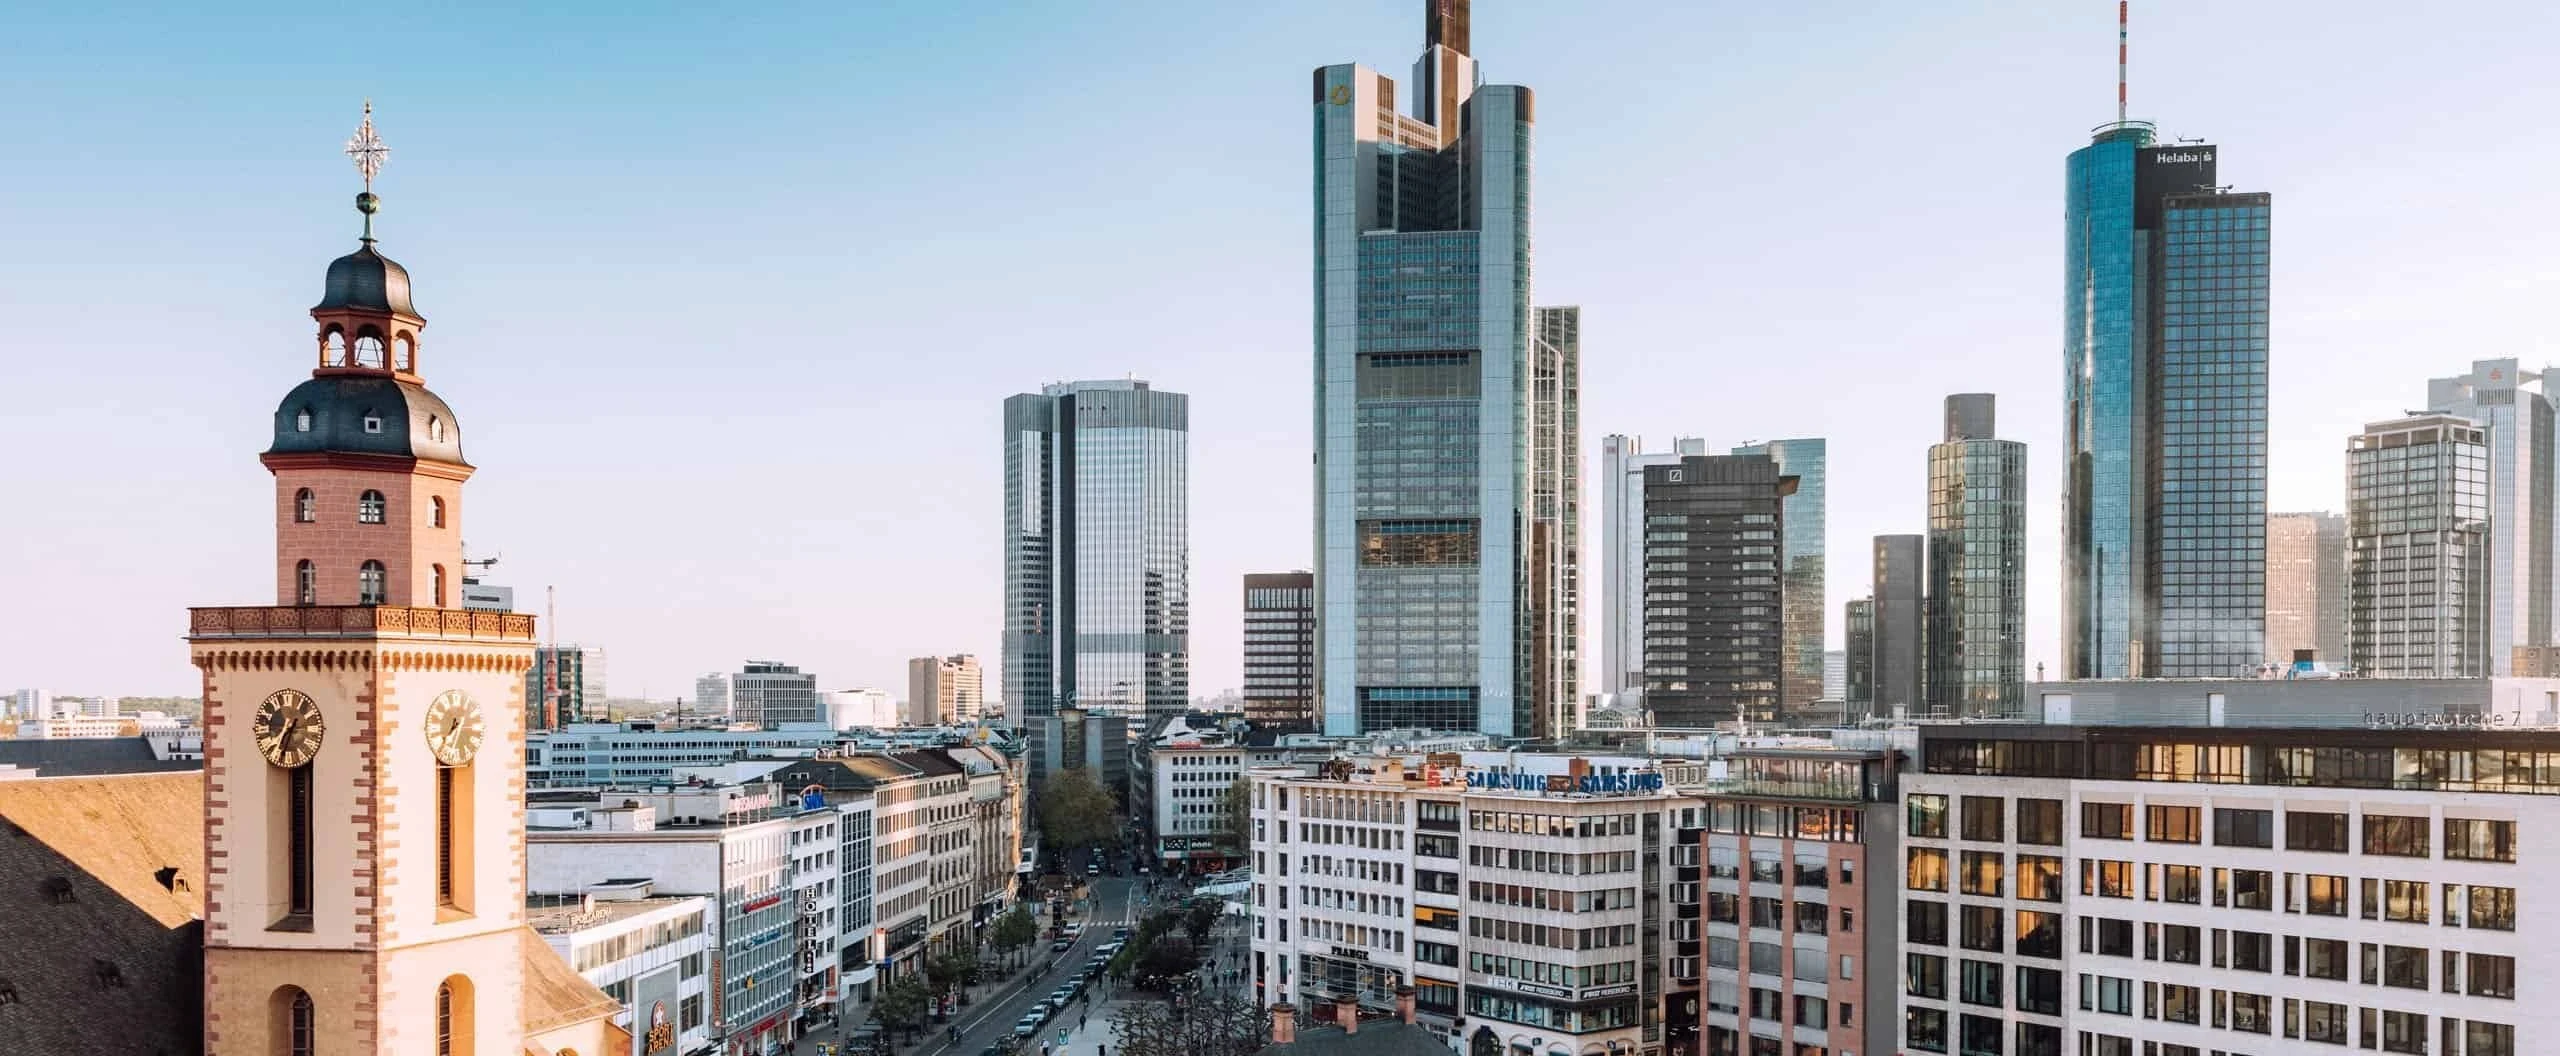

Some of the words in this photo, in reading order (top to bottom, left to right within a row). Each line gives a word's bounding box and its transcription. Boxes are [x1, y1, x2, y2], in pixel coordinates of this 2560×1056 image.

[2157, 152, 2198, 164] Helaba
[2512, 711, 2522, 727] 7
[1466, 771, 1547, 791] SAMSUNG
[1579, 772, 1664, 793] SAMSUNG
[806, 888, 815, 949] HOTEL
[649, 1022, 673, 1042] SPORT
[648, 1037, 674, 1056] ARENA
